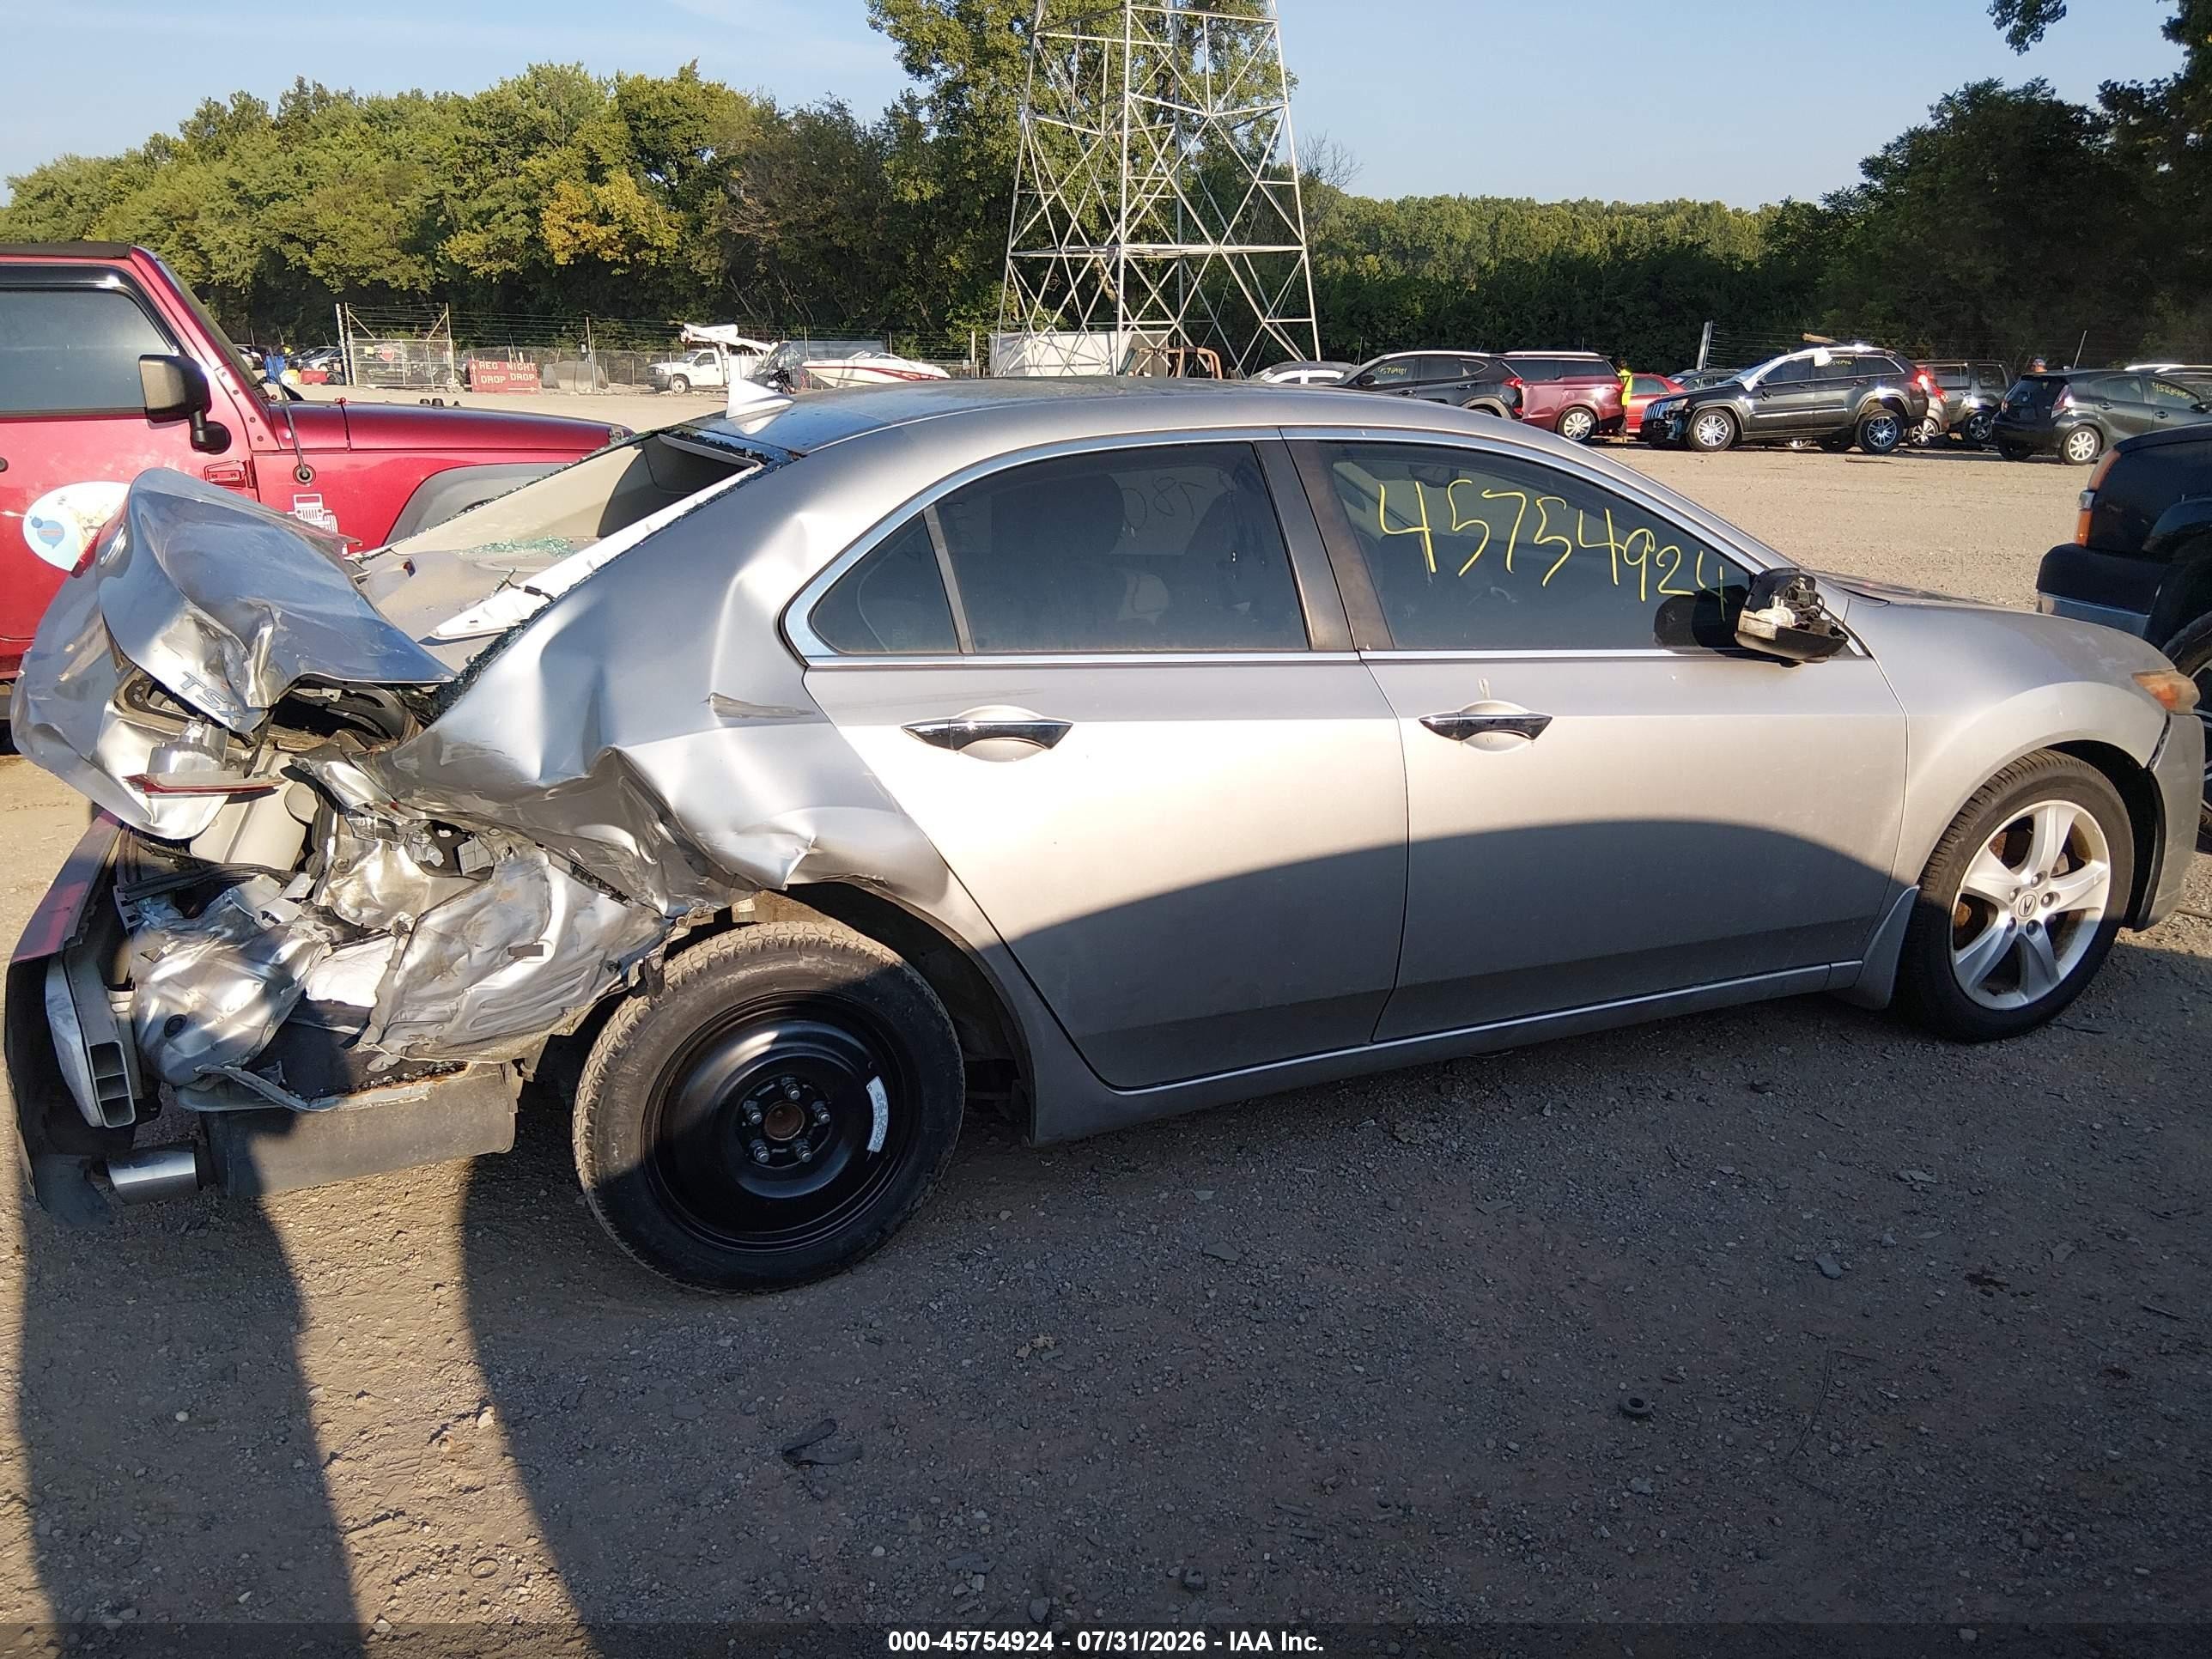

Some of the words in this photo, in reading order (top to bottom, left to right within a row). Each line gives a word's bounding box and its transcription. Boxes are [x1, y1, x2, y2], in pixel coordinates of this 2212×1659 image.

[507, 362, 536, 372] NIGHT
[481, 374, 507, 384] DROP
[510, 373, 535, 381] DROP
[1378, 479, 1729, 622] 45754924
[179, 671, 248, 729] TSX
